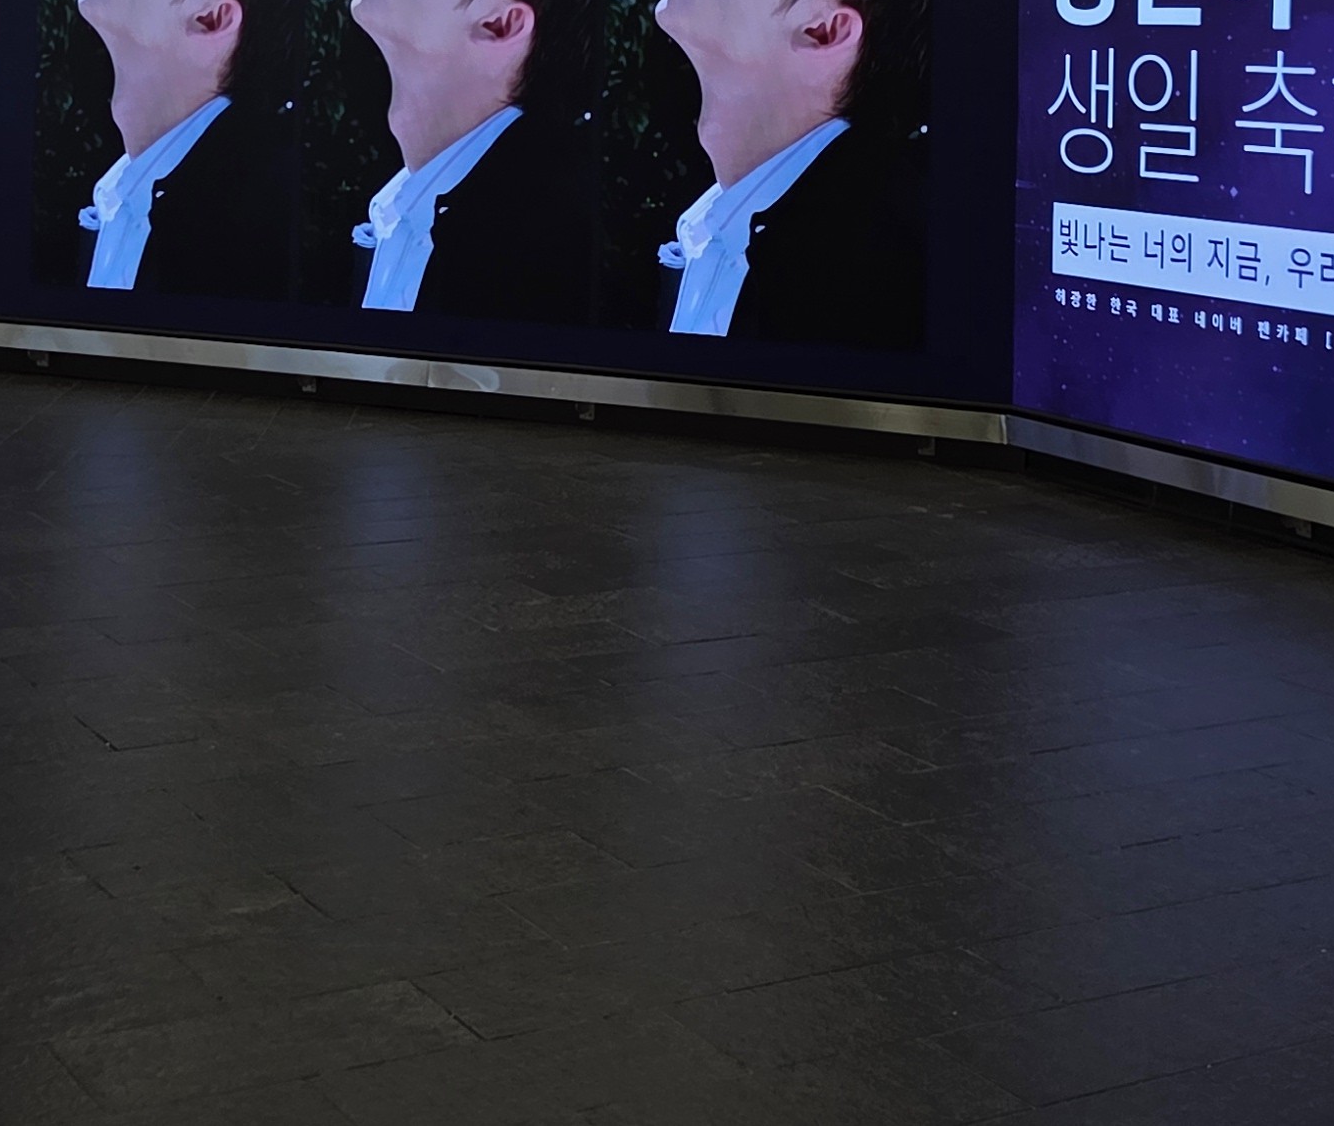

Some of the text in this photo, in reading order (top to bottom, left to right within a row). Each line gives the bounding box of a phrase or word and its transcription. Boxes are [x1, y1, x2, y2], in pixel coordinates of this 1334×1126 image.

[1047, 47, 1200, 183] 생일
[1059, 219, 1131, 263] 빛나는
[1144, 229, 1192, 273] 너의
[1207, 237, 1270, 286] 지금,
[1054, 287, 1098, 312] 허광한
[1110, 295, 1138, 318] 한국
[1151, 303, 1181, 324] 대표
[1195, 310, 1244, 336] 네이버
[1257, 320, 1309, 346] 팬카페
